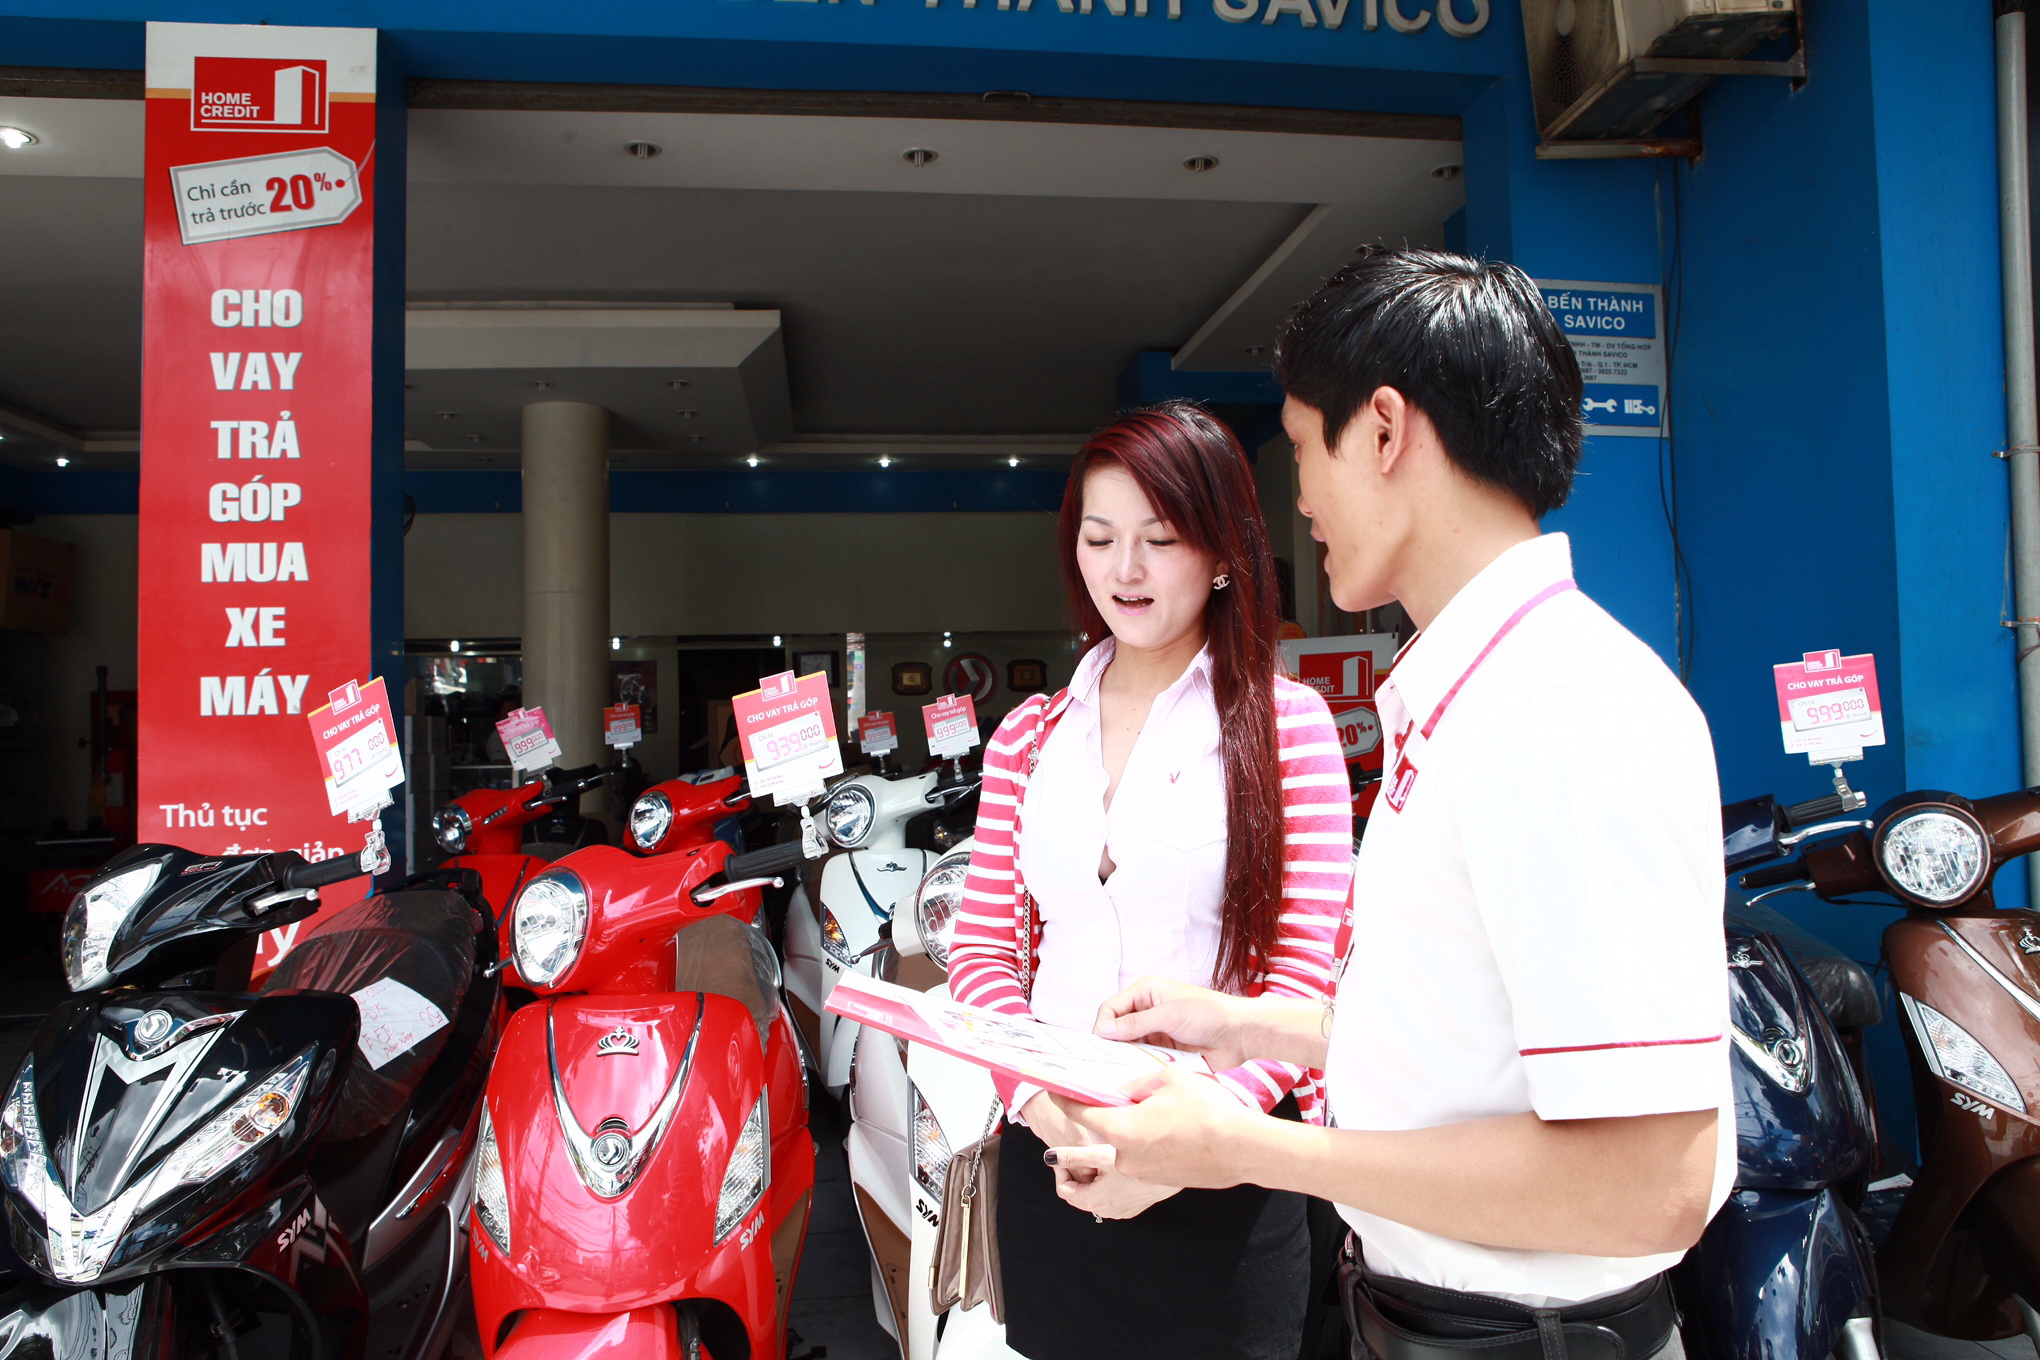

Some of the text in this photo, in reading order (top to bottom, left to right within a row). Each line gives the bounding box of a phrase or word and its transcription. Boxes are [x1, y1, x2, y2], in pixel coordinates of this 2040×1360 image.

[200, 105, 260, 118] CREDIT
[201, 92, 252, 105] HOME
[187, 172, 333, 213] Chỉ cần 20%
[192, 202, 267, 225] trả trước
[210, 289, 302, 328] CHO
[1547, 292, 1644, 313] BẾN THÀNH
[1564, 314, 1626, 330] SAVICO
[209, 352, 303, 390] VAY
[210, 411, 300, 459] TRẢ
[208, 475, 302, 522] GÓP
[200, 542, 309, 583] MUA
[224, 607, 286, 648] XE
[200, 668, 310, 717] MÁY
[1303, 677, 1330, 685] HOME
[1787, 674, 1864, 690] CHO VAY TRẢ GÓP
[323, 703, 380, 739] CHO VAY TRẢ GÓP
[746, 697, 818, 723] CHO VAY TRẢ GÓP
[334, 748, 362, 780] 977
[159, 803, 268, 831] Thủ tục
[825, 958, 840, 974] SYM
[1950, 1092, 1995, 1120] SYM
[277, 1207, 312, 1253] SYM
[740, 1210, 765, 1252] SYM
